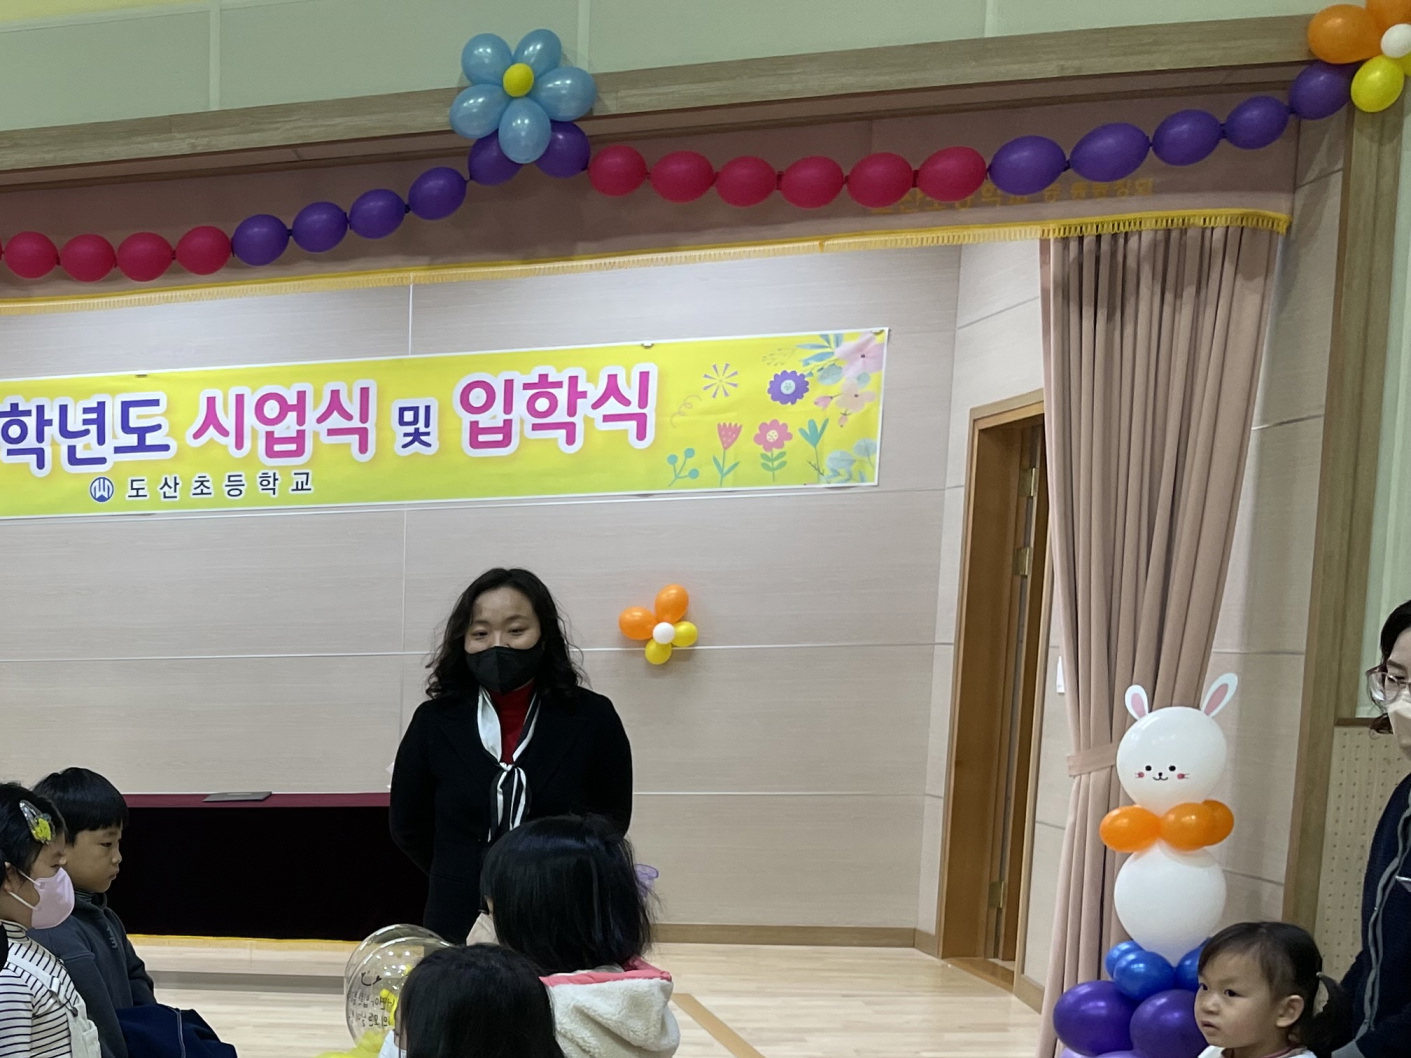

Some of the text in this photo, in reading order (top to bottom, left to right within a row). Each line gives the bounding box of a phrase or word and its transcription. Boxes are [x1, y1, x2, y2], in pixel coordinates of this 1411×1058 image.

[192, 386, 373, 460] 시업식
[398, 404, 431, 450] 및
[459, 370, 657, 449] 입학식
